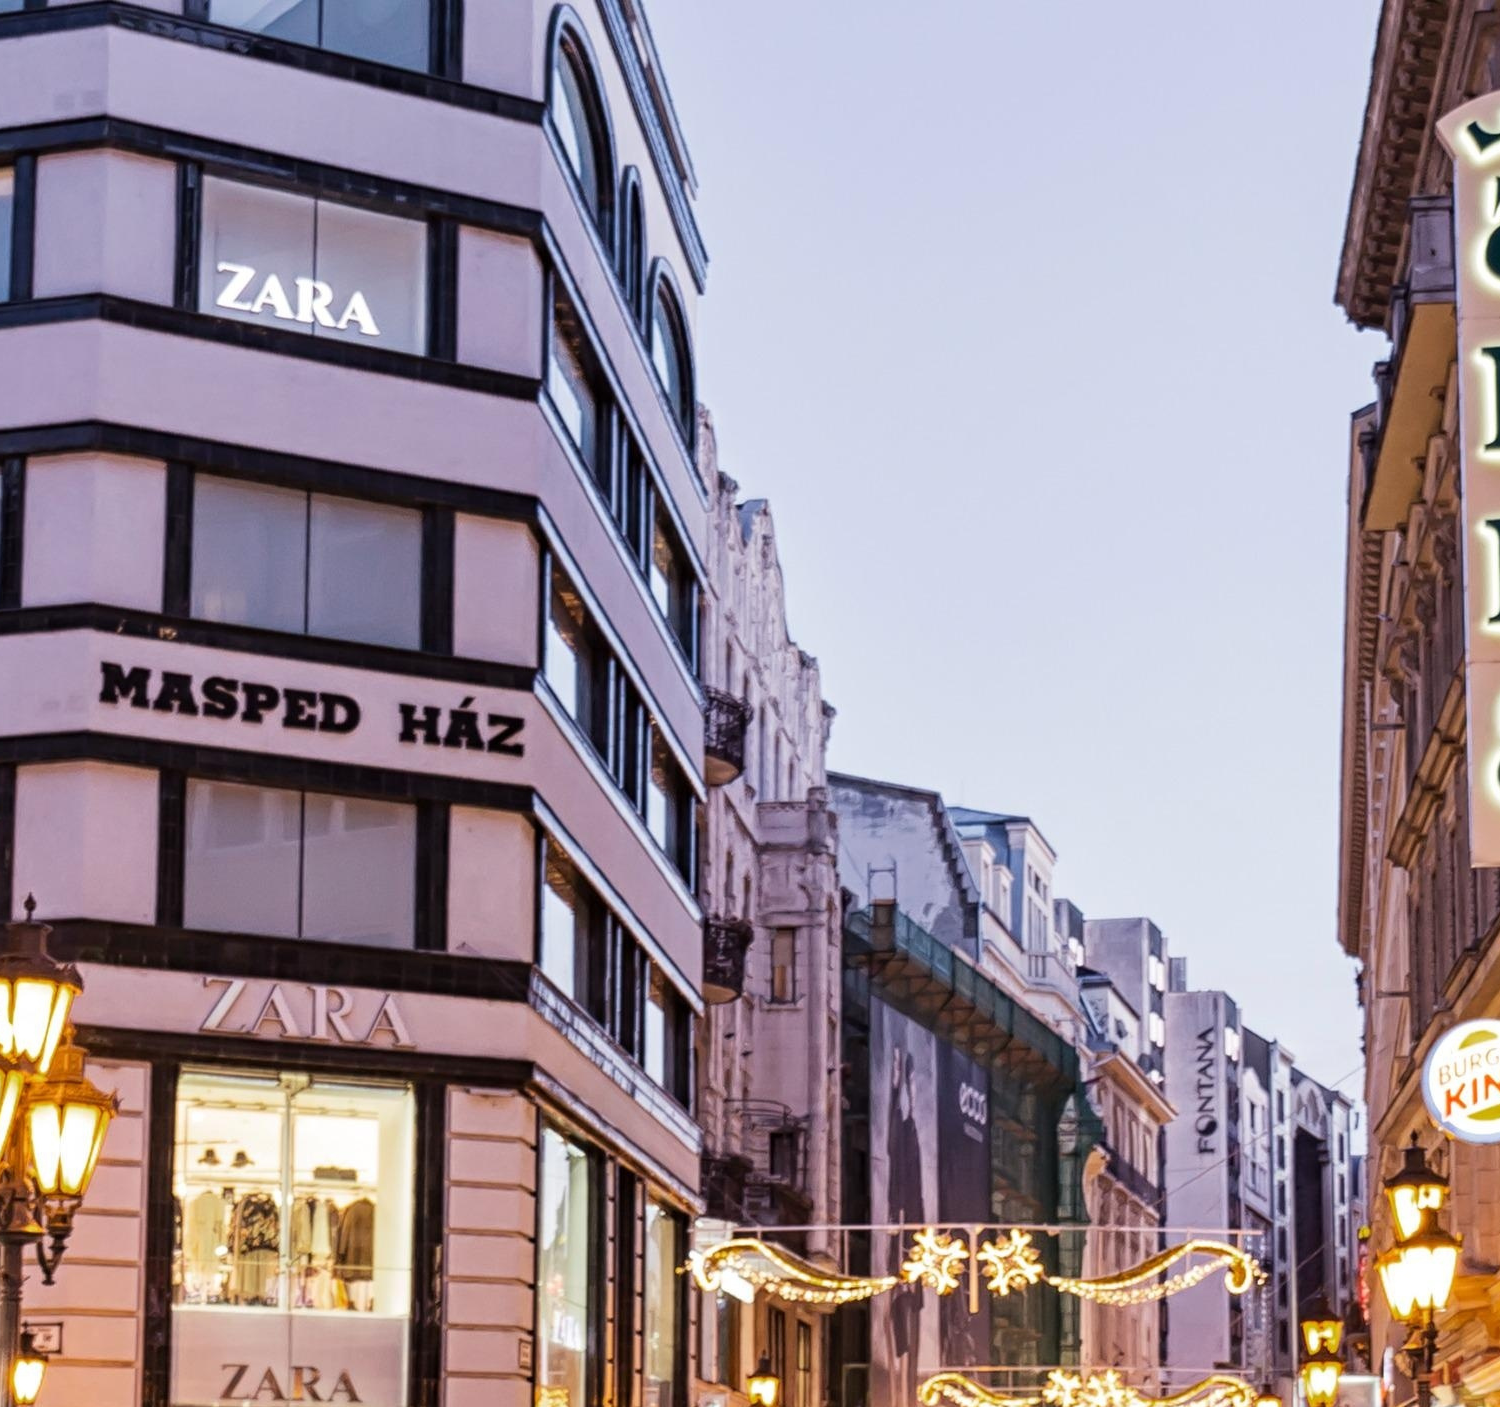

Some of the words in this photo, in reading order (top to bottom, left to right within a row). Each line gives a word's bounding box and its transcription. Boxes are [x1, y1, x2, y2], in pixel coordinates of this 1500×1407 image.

[215, 261, 381, 336] ZARA
[99, 662, 361, 735] MASPED
[398, 696, 526, 757] HÁZ
[200, 976, 417, 1049] ZARA
[1195, 1026, 1217, 1154] FONTANA
[221, 1363, 363, 1404] ZARA
